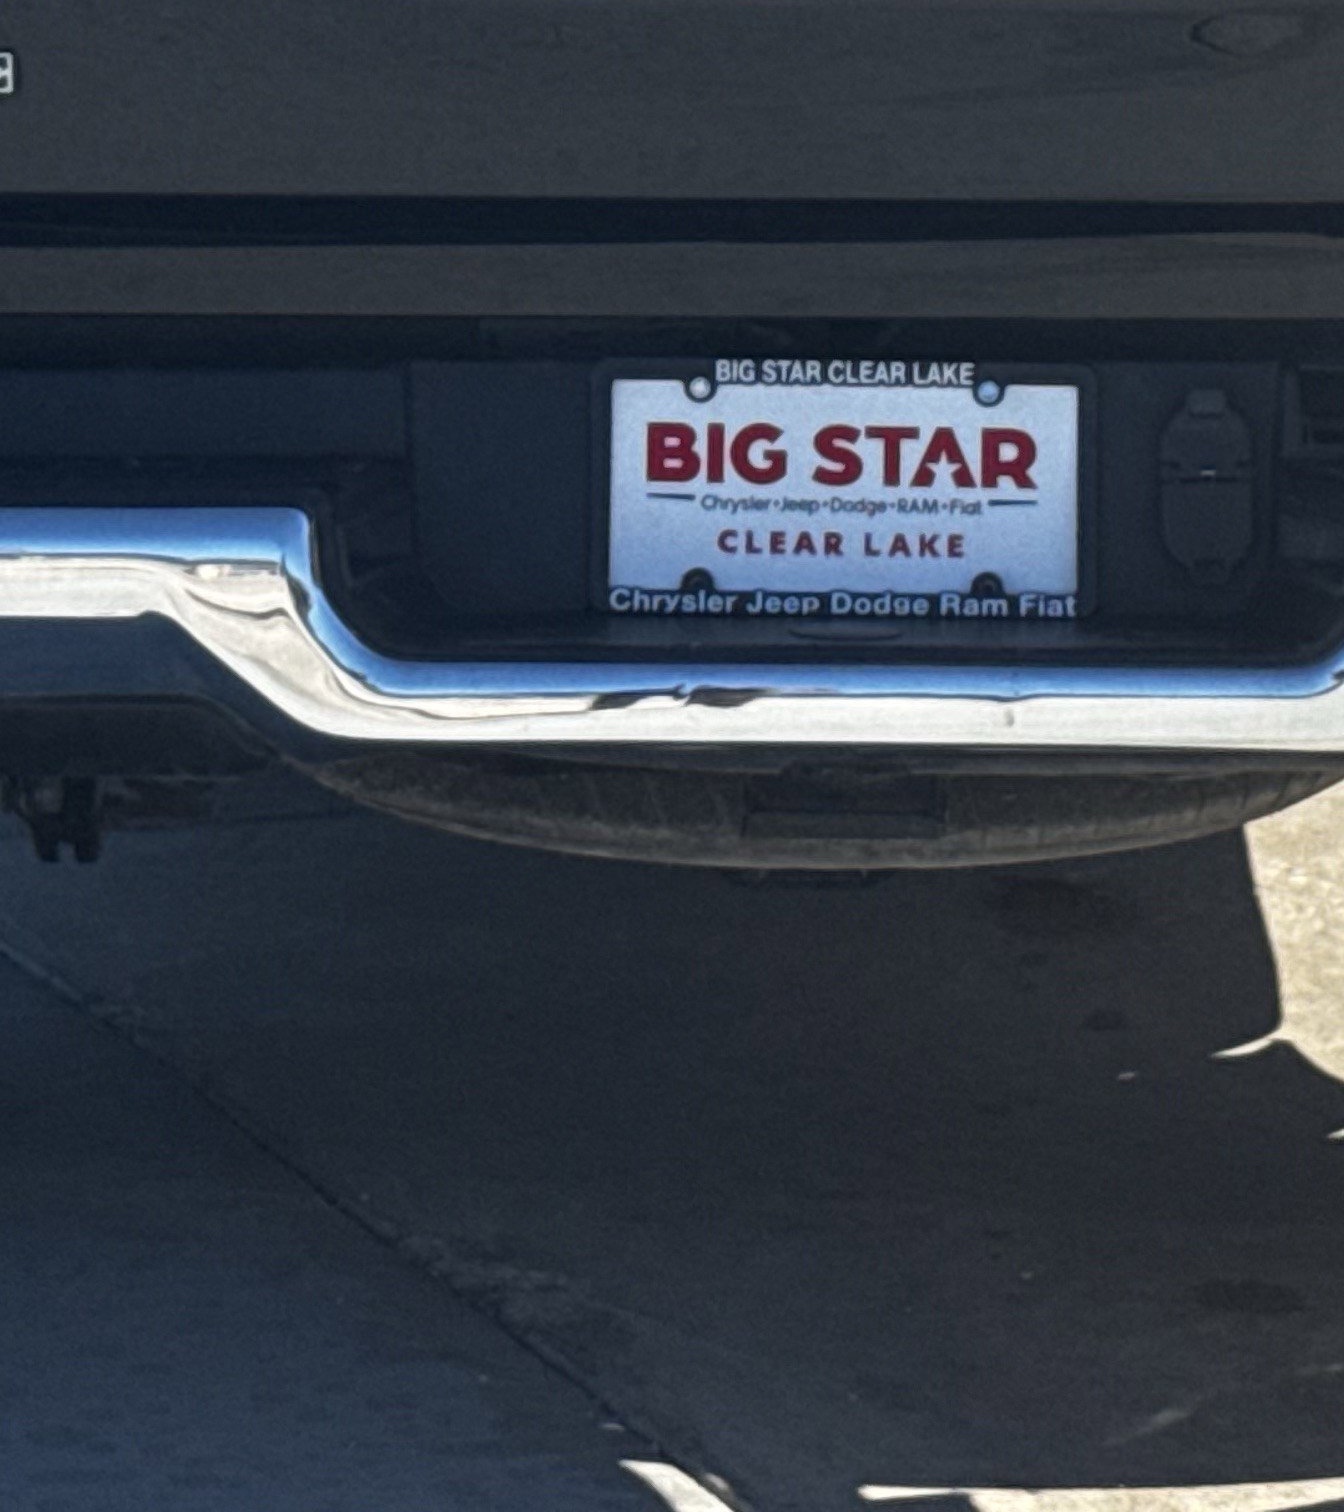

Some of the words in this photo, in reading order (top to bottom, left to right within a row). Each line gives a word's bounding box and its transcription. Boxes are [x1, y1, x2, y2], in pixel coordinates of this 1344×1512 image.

[715, 359, 755, 382] BIG
[762, 360, 821, 383] STAR
[828, 360, 905, 384] CLEAR
[912, 362, 975, 385] LAKE
[647, 422, 787, 485] BIG
[812, 424, 1038, 488] STAR
[717, 529, 844, 555] CLEAR
[864, 532, 964, 557] LAKE
[609, 589, 737, 614] Chrysler
[746, 591, 820, 615] Jeep
[831, 592, 930, 616] Dodge
[940, 594, 1008, 616] Ram
[1019, 594, 1076, 617] Fiat
